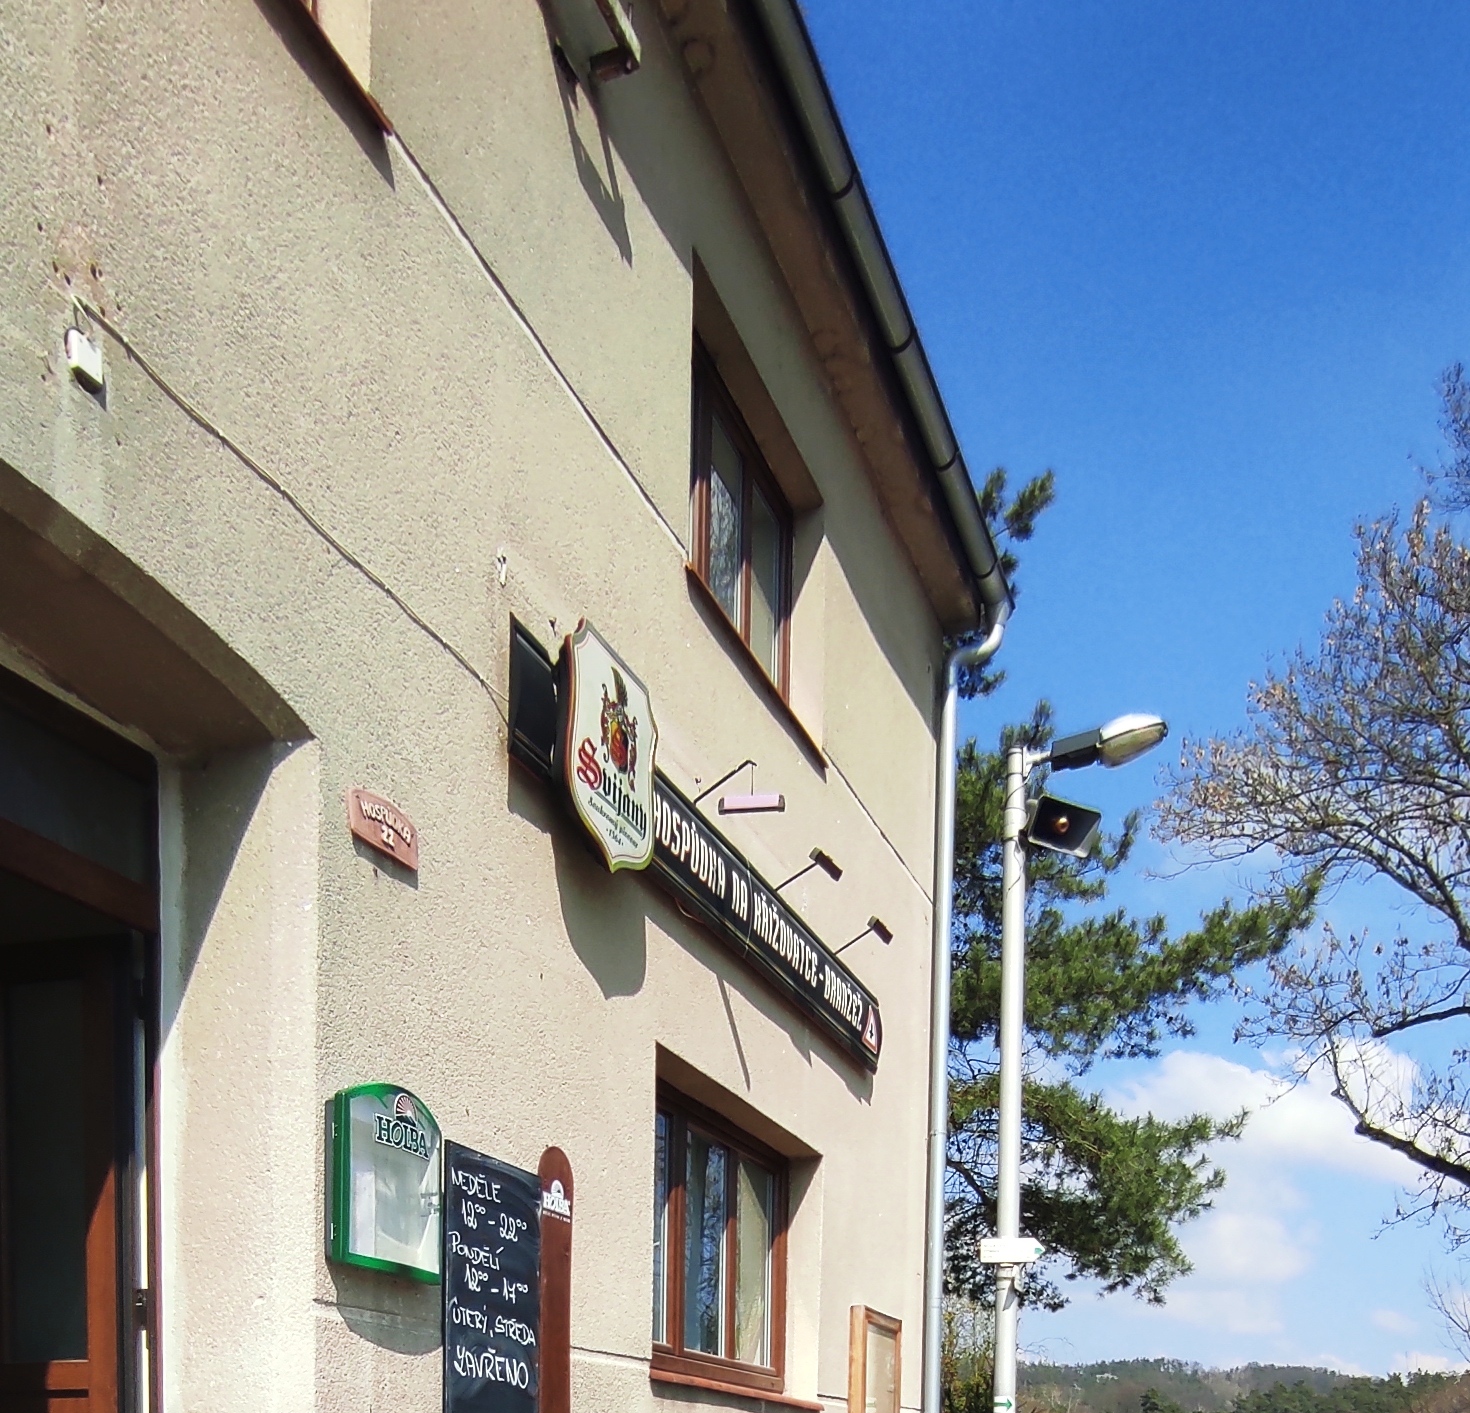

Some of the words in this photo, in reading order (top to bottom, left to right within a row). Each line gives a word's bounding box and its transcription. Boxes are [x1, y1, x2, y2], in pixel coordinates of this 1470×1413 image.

[576, 737, 647, 841] Svijany
[381, 825, 395, 847] 22
[731, 870, 748, 922] NA
[375, 1112, 430, 1161] HOLBA
[542, 1191, 571, 1217] HOLBA
